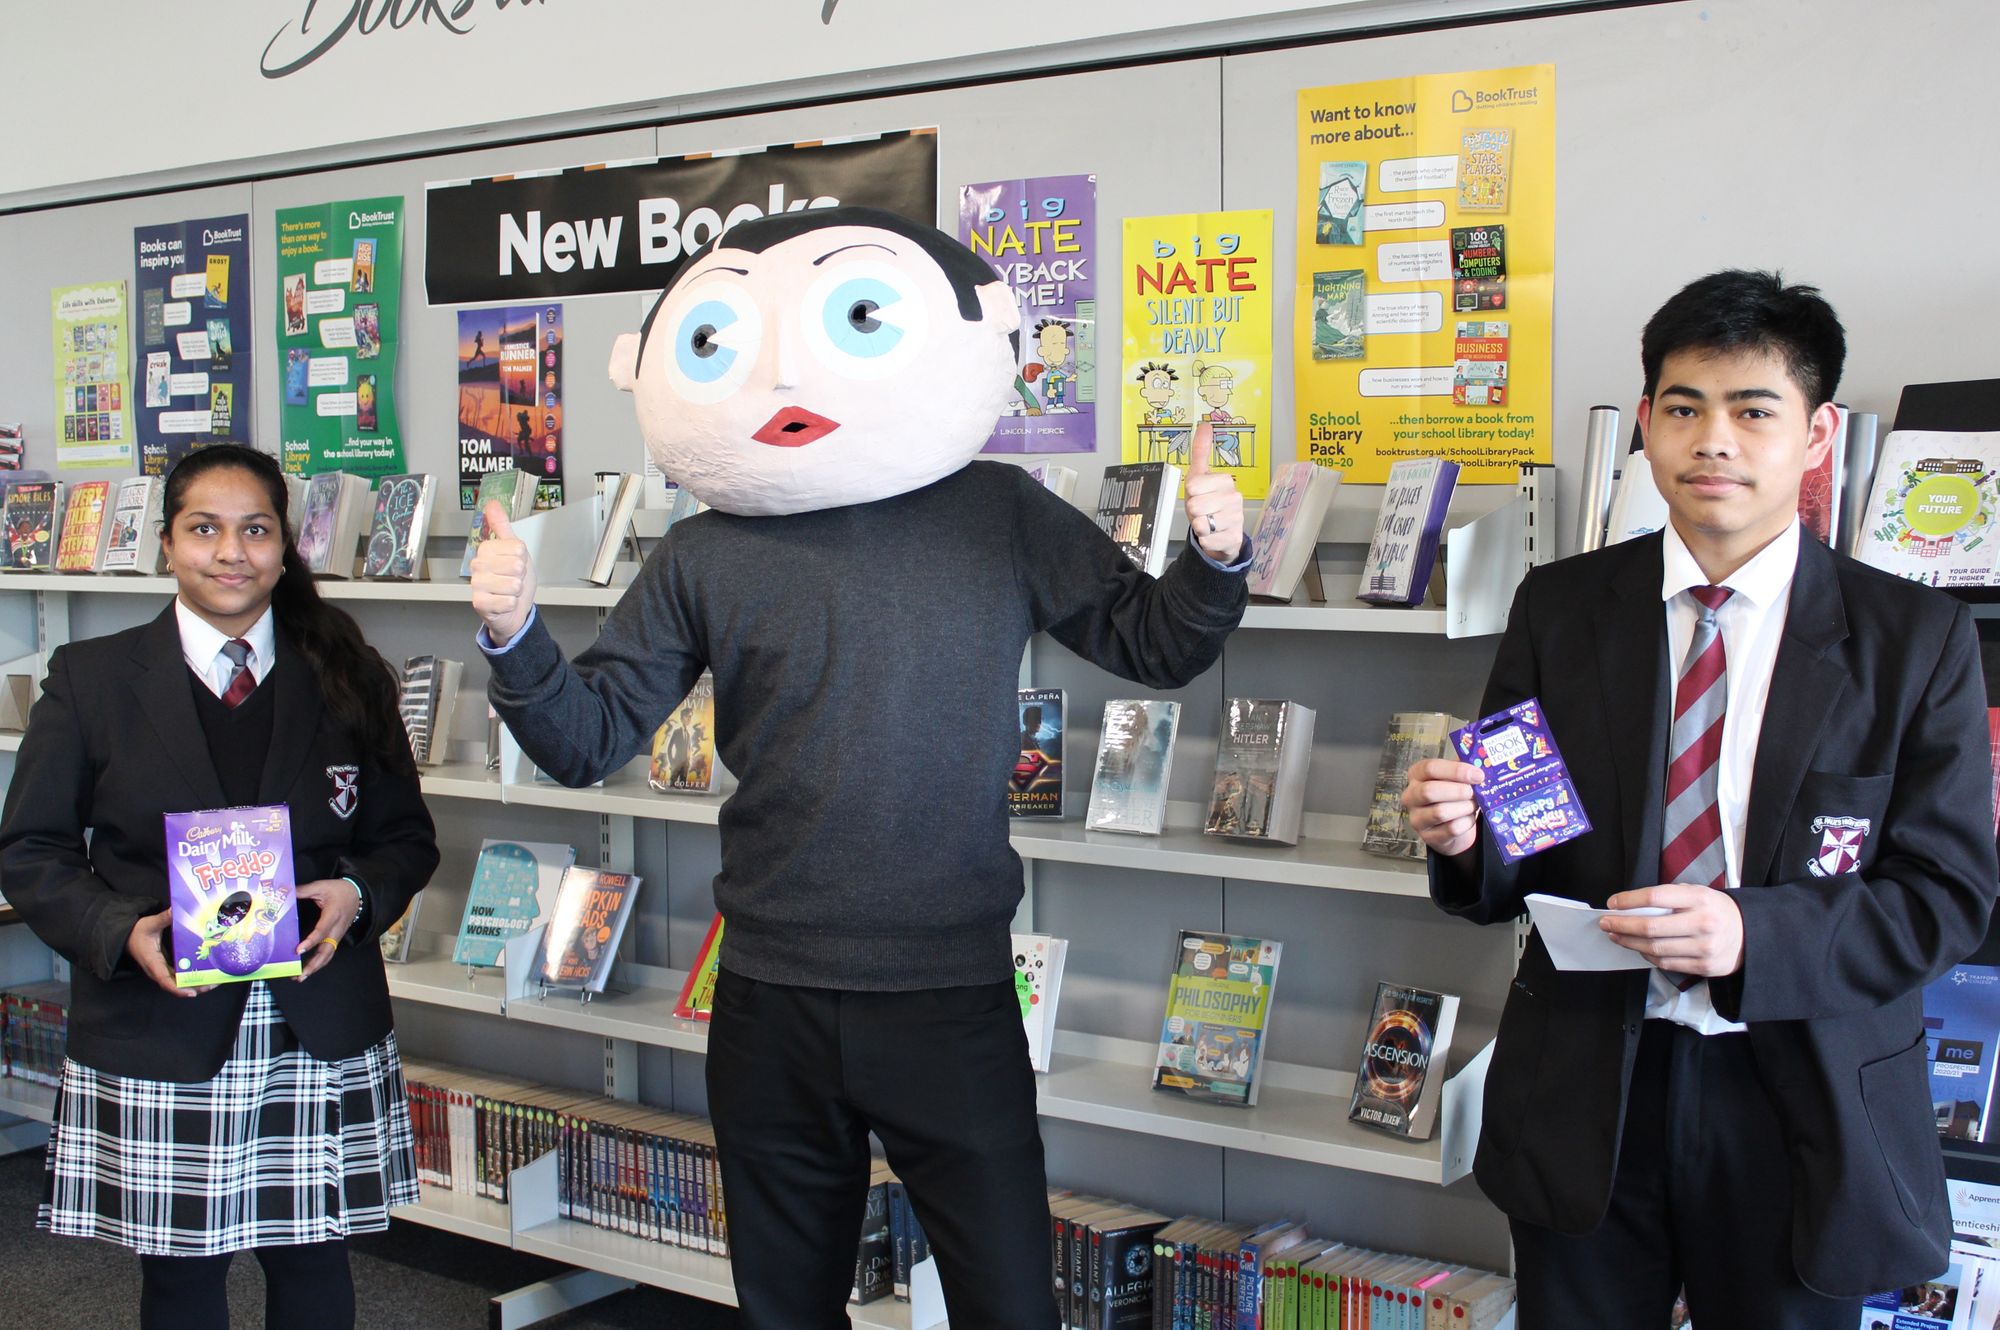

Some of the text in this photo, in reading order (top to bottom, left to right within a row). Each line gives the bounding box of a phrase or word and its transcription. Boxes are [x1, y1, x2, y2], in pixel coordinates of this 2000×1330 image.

[1476, 87, 1538, 103] BookTrust
[1310, 102, 1416, 124] Want to know
[1310, 124, 1414, 145] more about...
[1472, 153, 1496, 164] STAR
[1465, 164, 1502, 176] PLAYERS
[362, 211, 395, 223] BookTrust
[305, 220, 321, 229] more
[213, 228, 242, 240] BookTrust
[281, 231, 327, 244] than one way to
[970, 219, 1081, 257] NATE
[1470, 231, 1488, 241] 100
[140, 239, 182, 253] Books can
[499, 210, 623, 276] New
[1153, 233, 1240, 258] big
[281, 246, 298, 257] enjoy
[140, 254, 185, 270] inspire you
[1459, 256, 1501, 269] COMPUTERS
[994, 258, 1089, 285] YBACK
[1136, 257, 1257, 296] NATE
[1464, 267, 1497, 277] & CODING
[1317, 281, 1361, 293] LIGHTNING
[1013, 282, 1065, 308] ME!
[1327, 291, 1349, 300] MARY
[1146, 296, 1245, 326] SILENT BUT
[1162, 326, 1226, 354] DEADLY
[500, 348, 535, 361] RUNNER
[1456, 343, 1503, 353] BUSINESS
[512, 364, 533, 372] PALMER
[1310, 412, 1360, 426] School
[1426, 414, 1464, 424] borrow
[1466, 416, 1473, 424] a
[1475, 413, 1504, 424] book
[1506, 412, 1534, 424] from
[1310, 427, 1363, 444] Library
[1393, 427, 1534, 442] your school library today!
[144, 444, 168, 454] School
[285, 440, 310, 451] School
[360, 438, 372, 448] your
[373, 438, 384, 447] way
[385, 437, 392, 445] in
[461, 439, 492, 454] TOM
[1310, 442, 1345, 456] Pack
[285, 451, 311, 464] Library
[323, 450, 335, 459] the
[336, 449, 354, 458] school
[354, 448, 373, 459] library
[144, 464, 161, 474] Pack
[285, 462, 302, 472] Pack
[461, 456, 514, 473] PALMER
[33, 490, 51, 502] BILES
[1099, 476, 1144, 512] Who put
[1928, 494, 1958, 503] YOUR
[394, 492, 414, 510] ICE
[1918, 505, 1963, 514] FUTURE
[1113, 513, 1143, 547] song
[61, 533, 97, 553] STEVEN
[1233, 733, 1269, 744] HITLER
[1488, 735, 1523, 757] BOOK
[1008, 792, 1058, 801] PERMAN
[1509, 797, 1555, 825] Happy
[186, 825, 223, 842] Cadbury
[1511, 809, 1568, 845] Birthday
[178, 829, 261, 858] Dairy Milk
[194, 851, 274, 890] Freddo
[600, 875, 627, 887] ROWELL
[471, 906, 495, 917] HOW
[468, 916, 530, 930] PSYCHOLOGY
[466, 925, 502, 937] WORKS
[1175, 986, 1263, 1015] PHILOSOPHY
[1363, 1042, 1430, 1069] ASCENSION
[1945, 1047, 1974, 1059] me
[1936, 1063, 1977, 1072] PROSPECTUS
[1360, 1106, 1401, 1126] VICTOR DIXEN
